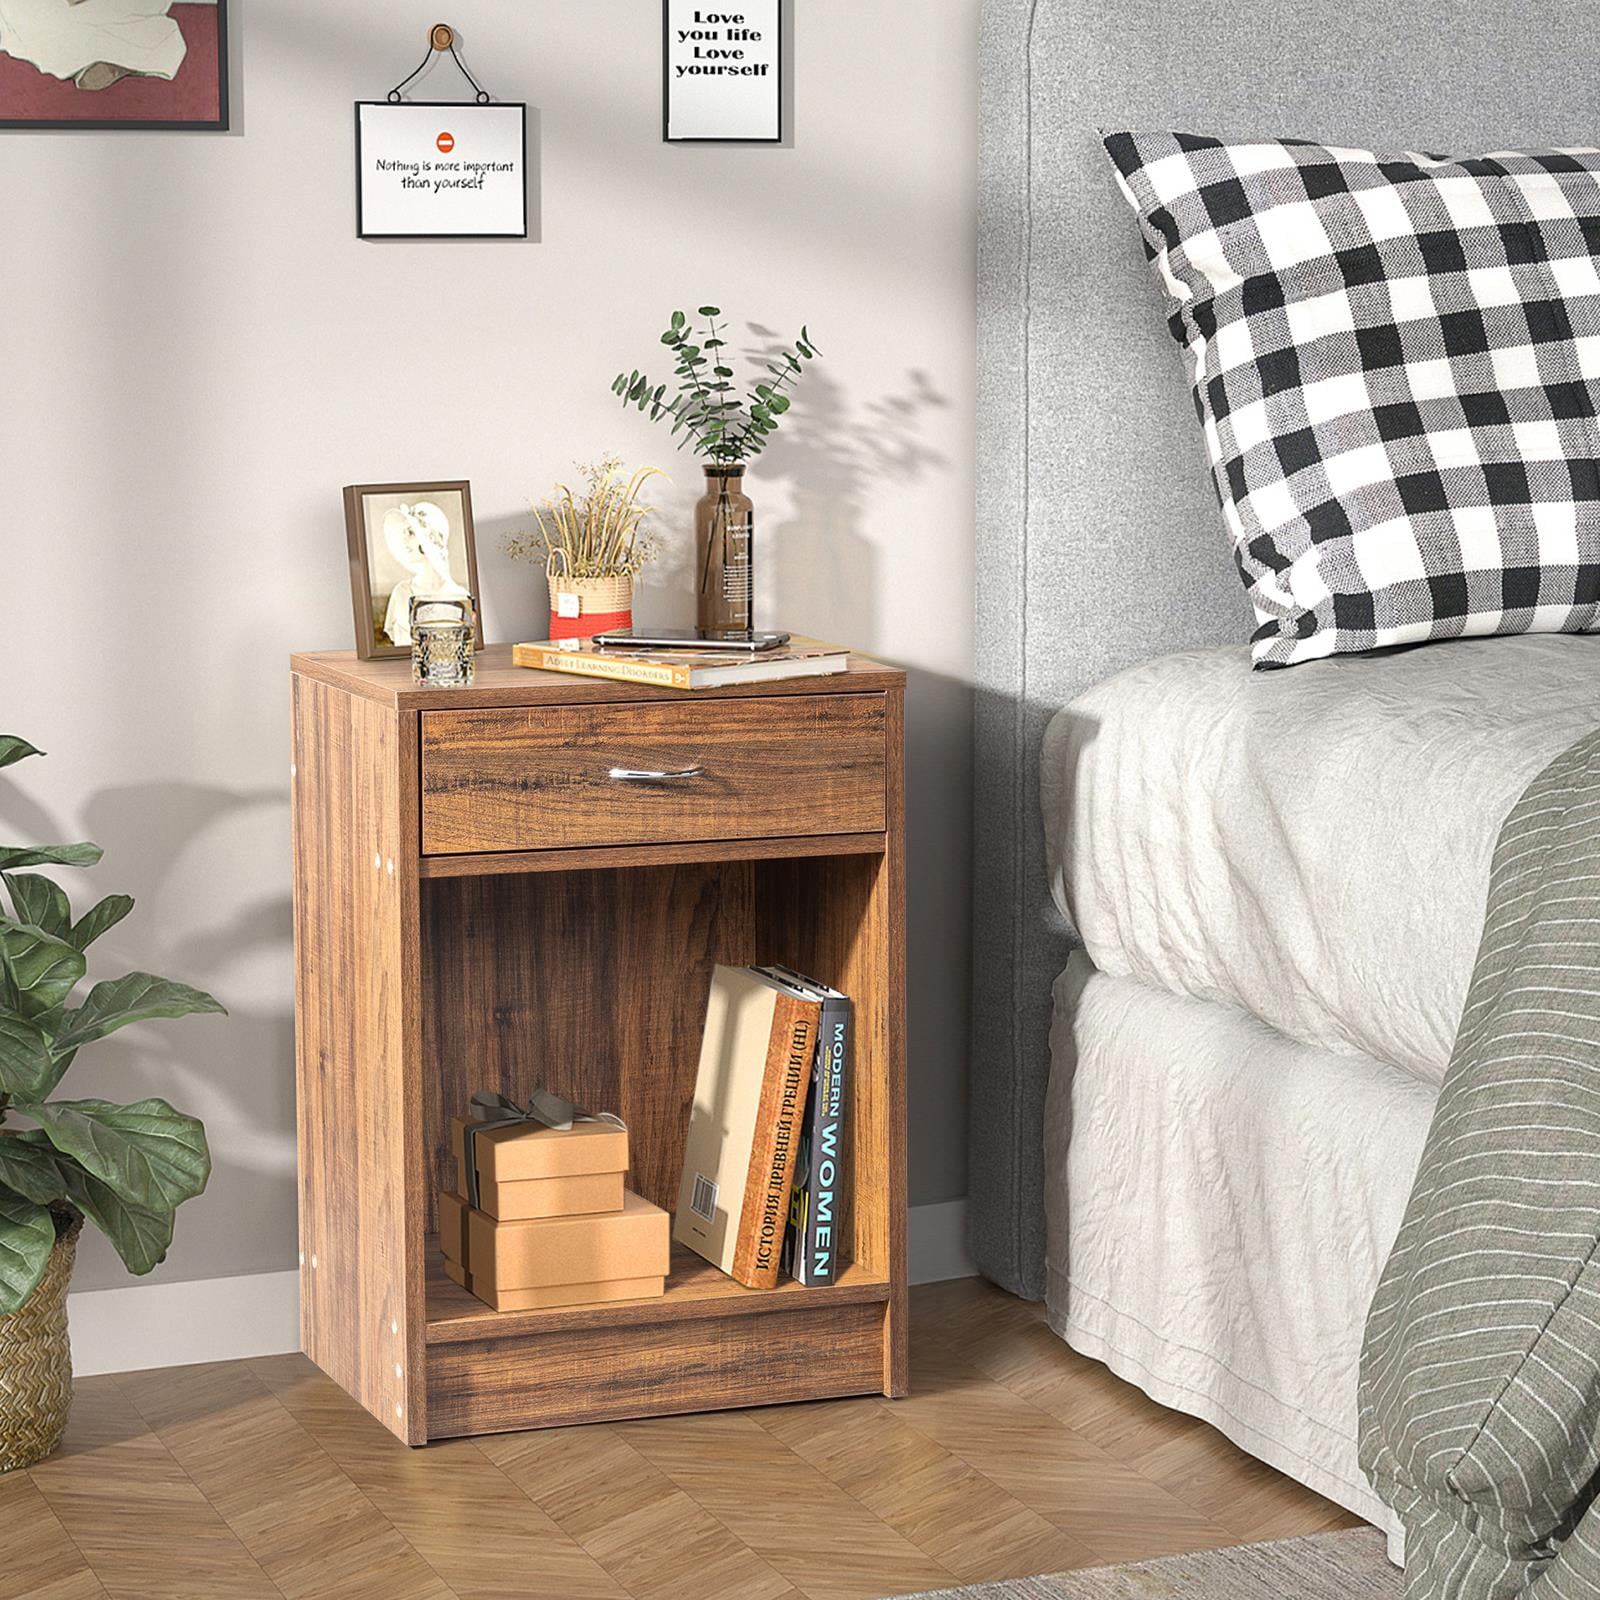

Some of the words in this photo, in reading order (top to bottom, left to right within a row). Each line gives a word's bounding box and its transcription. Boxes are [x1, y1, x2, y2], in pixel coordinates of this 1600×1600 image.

[694, 11, 745, 24] Love
[677, 30, 718, 43] you
[726, 28, 762, 41] life
[694, 46, 744, 60] Love
[675, 63, 769, 78] yourself
[376, 159, 420, 176] Nothing
[422, 160, 431, 172] is
[435, 161, 460, 172] more
[463, 160, 514, 175] important
[401, 176, 430, 189] than
[434, 172, 486, 194] yourself
[829, 1023, 845, 1117] MODERN
[756, 1193, 781, 1270] ИСТОРИЯ
[769, 1121, 793, 1192] ДРЕВНЕЙ
[781, 1054, 803, 1116] ГРЕЦИИ
[813, 1122, 839, 1278] WOMEN
